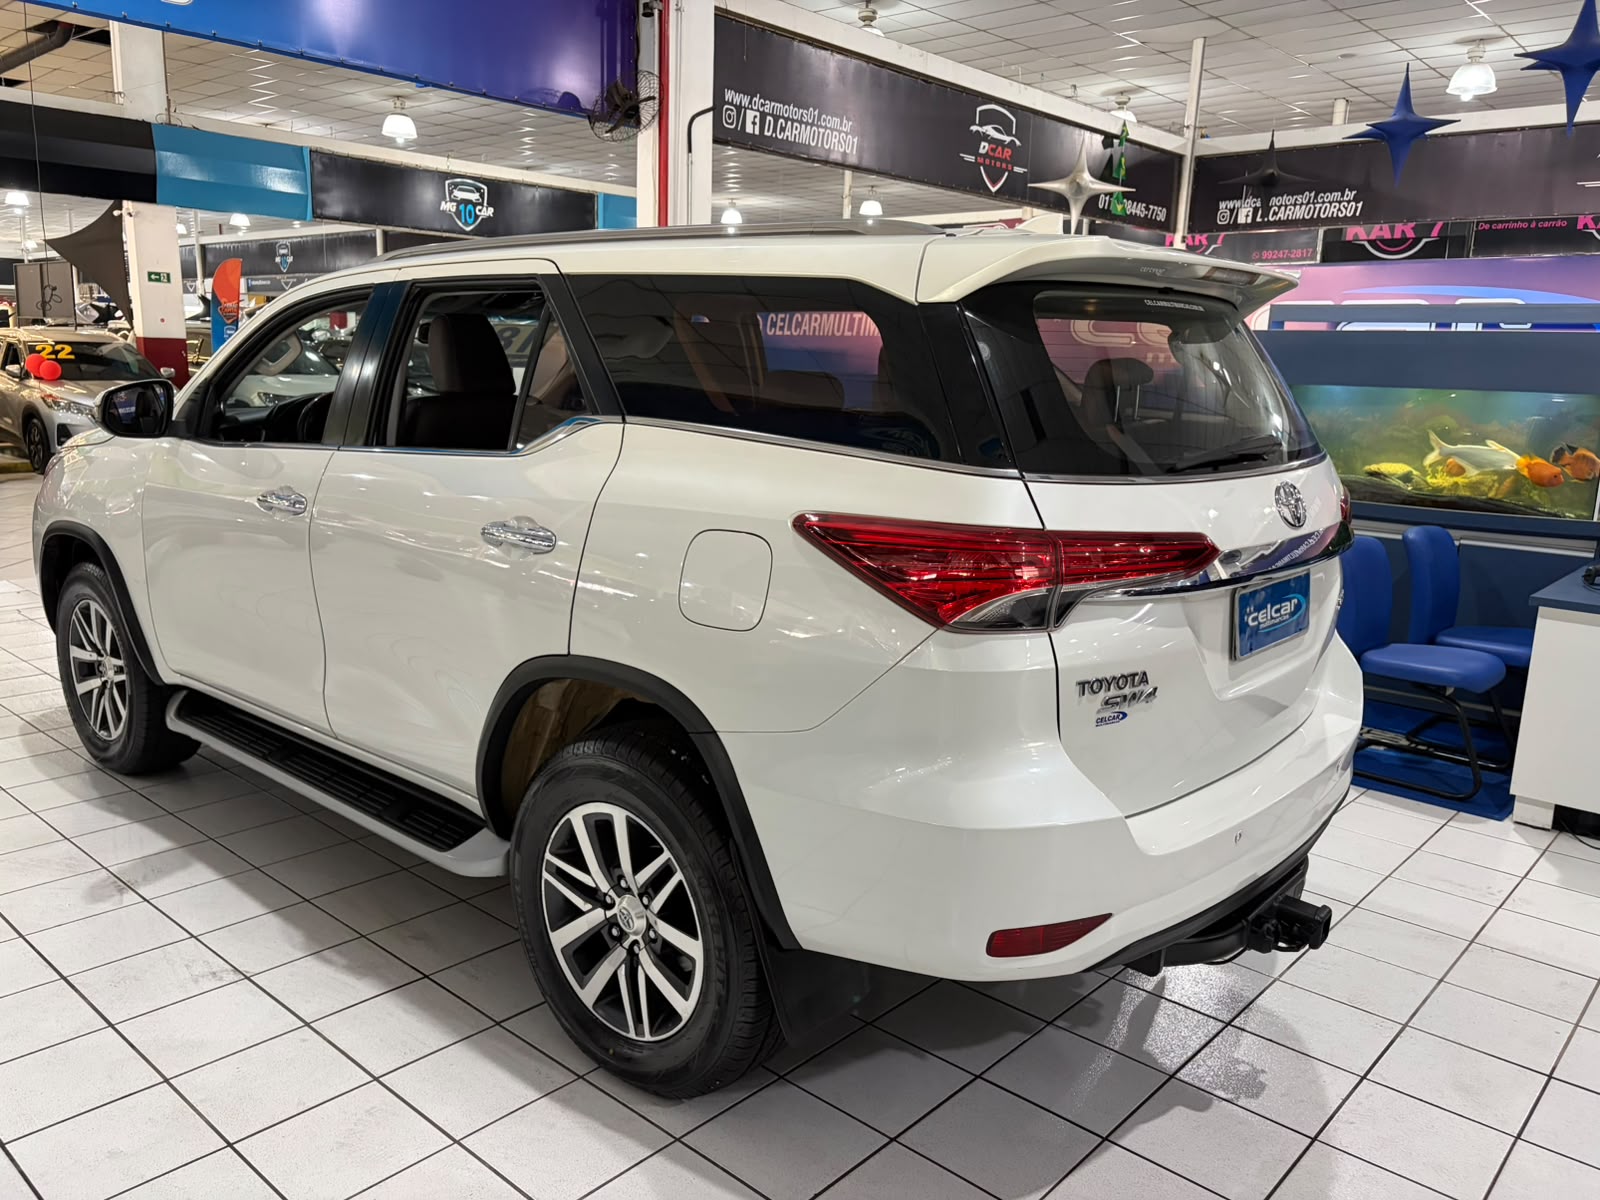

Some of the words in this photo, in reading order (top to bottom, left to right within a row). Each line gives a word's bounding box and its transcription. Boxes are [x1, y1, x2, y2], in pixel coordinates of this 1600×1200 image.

[724, 88, 852, 133] www.dcarmotors01.com.br
[764, 115, 858, 155] D.CARMOTORS01
[979, 141, 1012, 161] DCAR
[977, 156, 1012, 171] MOTORS
[440, 201, 457, 212] MG
[459, 203, 475, 225] 10
[475, 205, 494, 217] CAR
[1478, 222, 1490, 230] De
[1491, 220, 1528, 230] carrinho
[1247, 598, 1298, 627] celcar
[1076, 670, 1149, 698] TOYOTA
[1095, 713, 1121, 725] CELCAR
